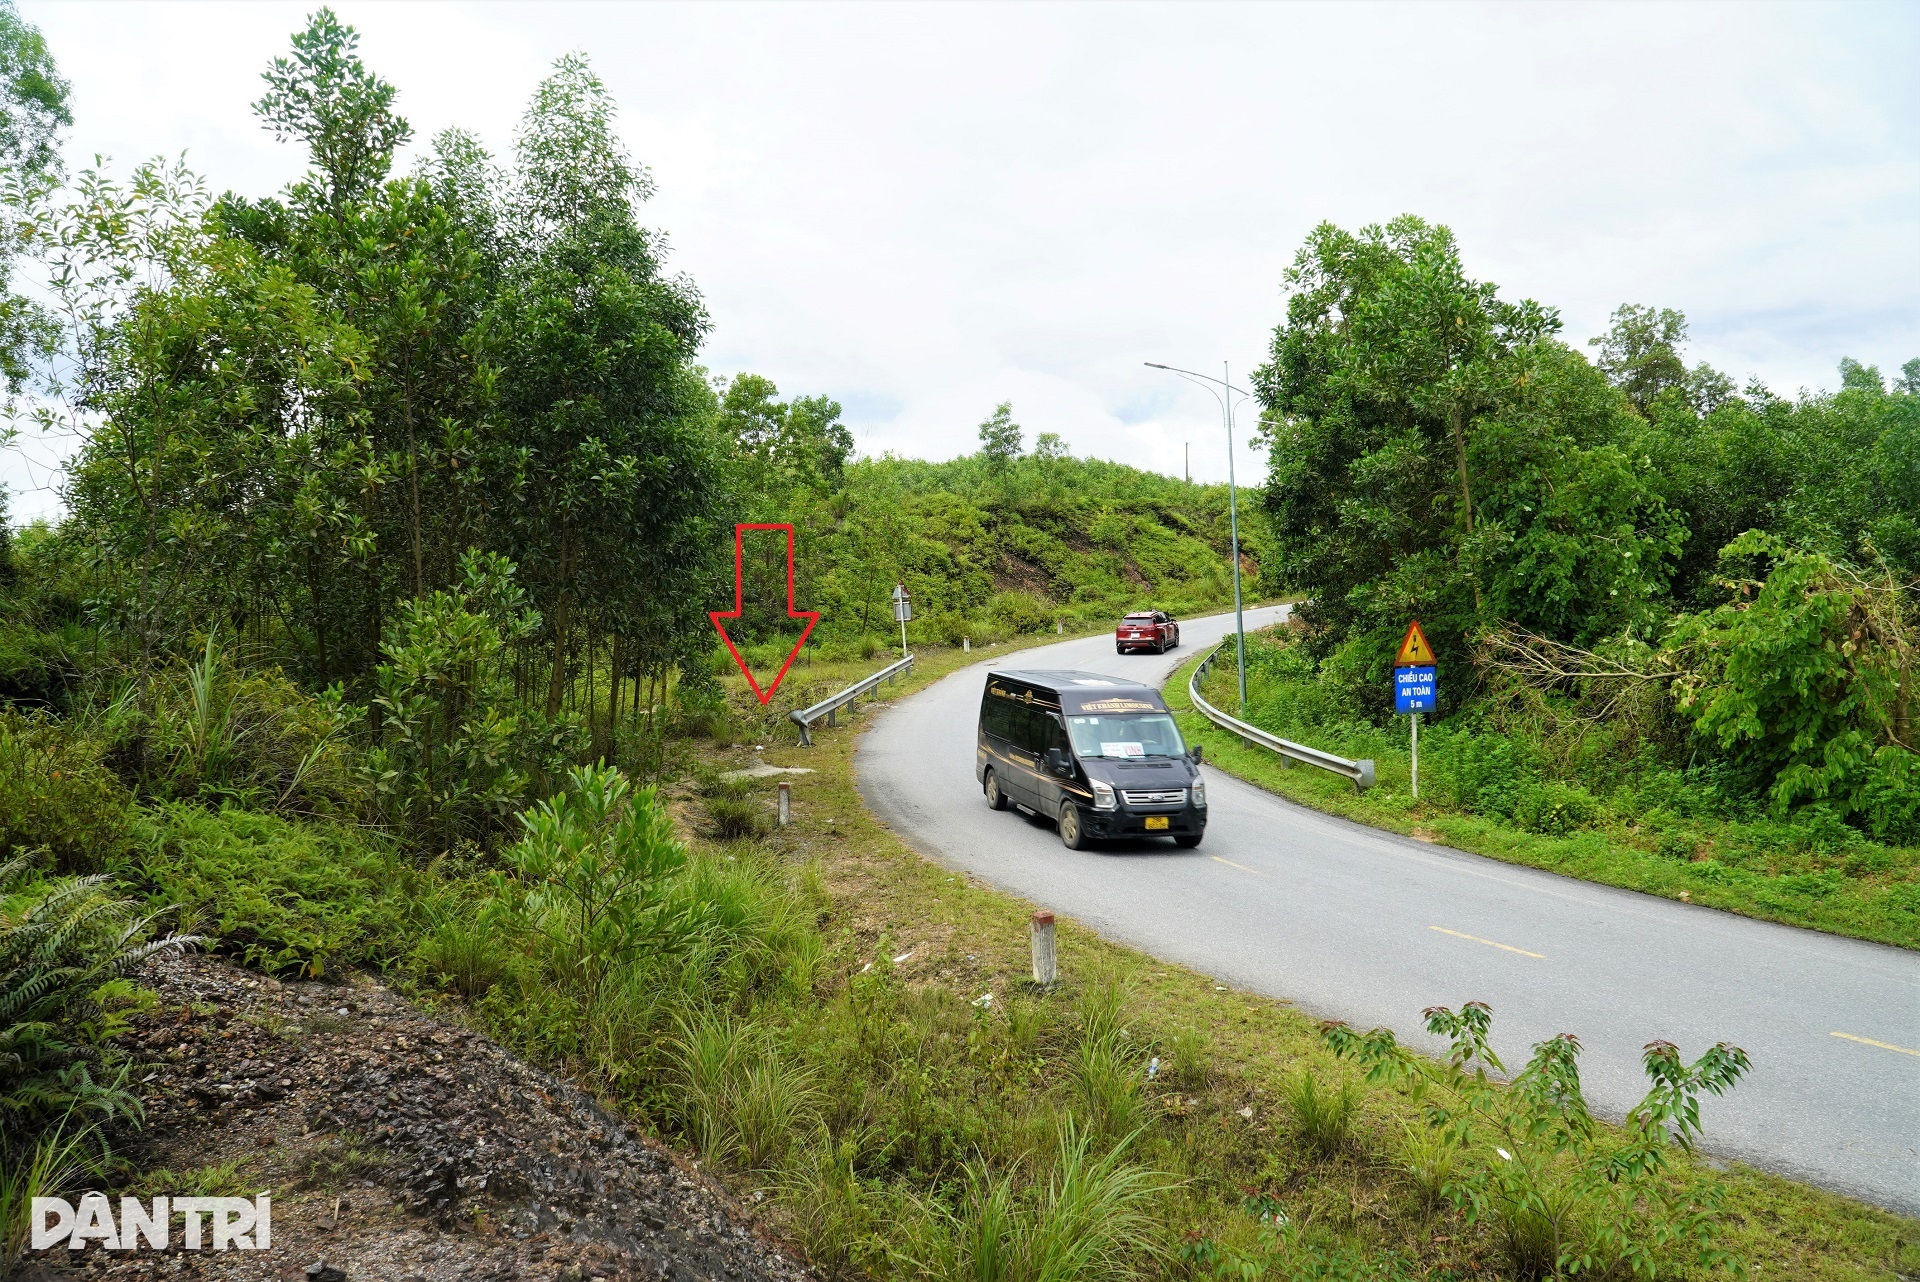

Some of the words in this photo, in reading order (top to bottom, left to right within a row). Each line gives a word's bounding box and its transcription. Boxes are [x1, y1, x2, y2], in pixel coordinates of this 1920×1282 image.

[1419, 673, 1433, 682] CAO
[1402, 688, 1411, 696] AN
[1413, 685, 1430, 695] TOÀN
[1410, 700, 1415, 708] 5
